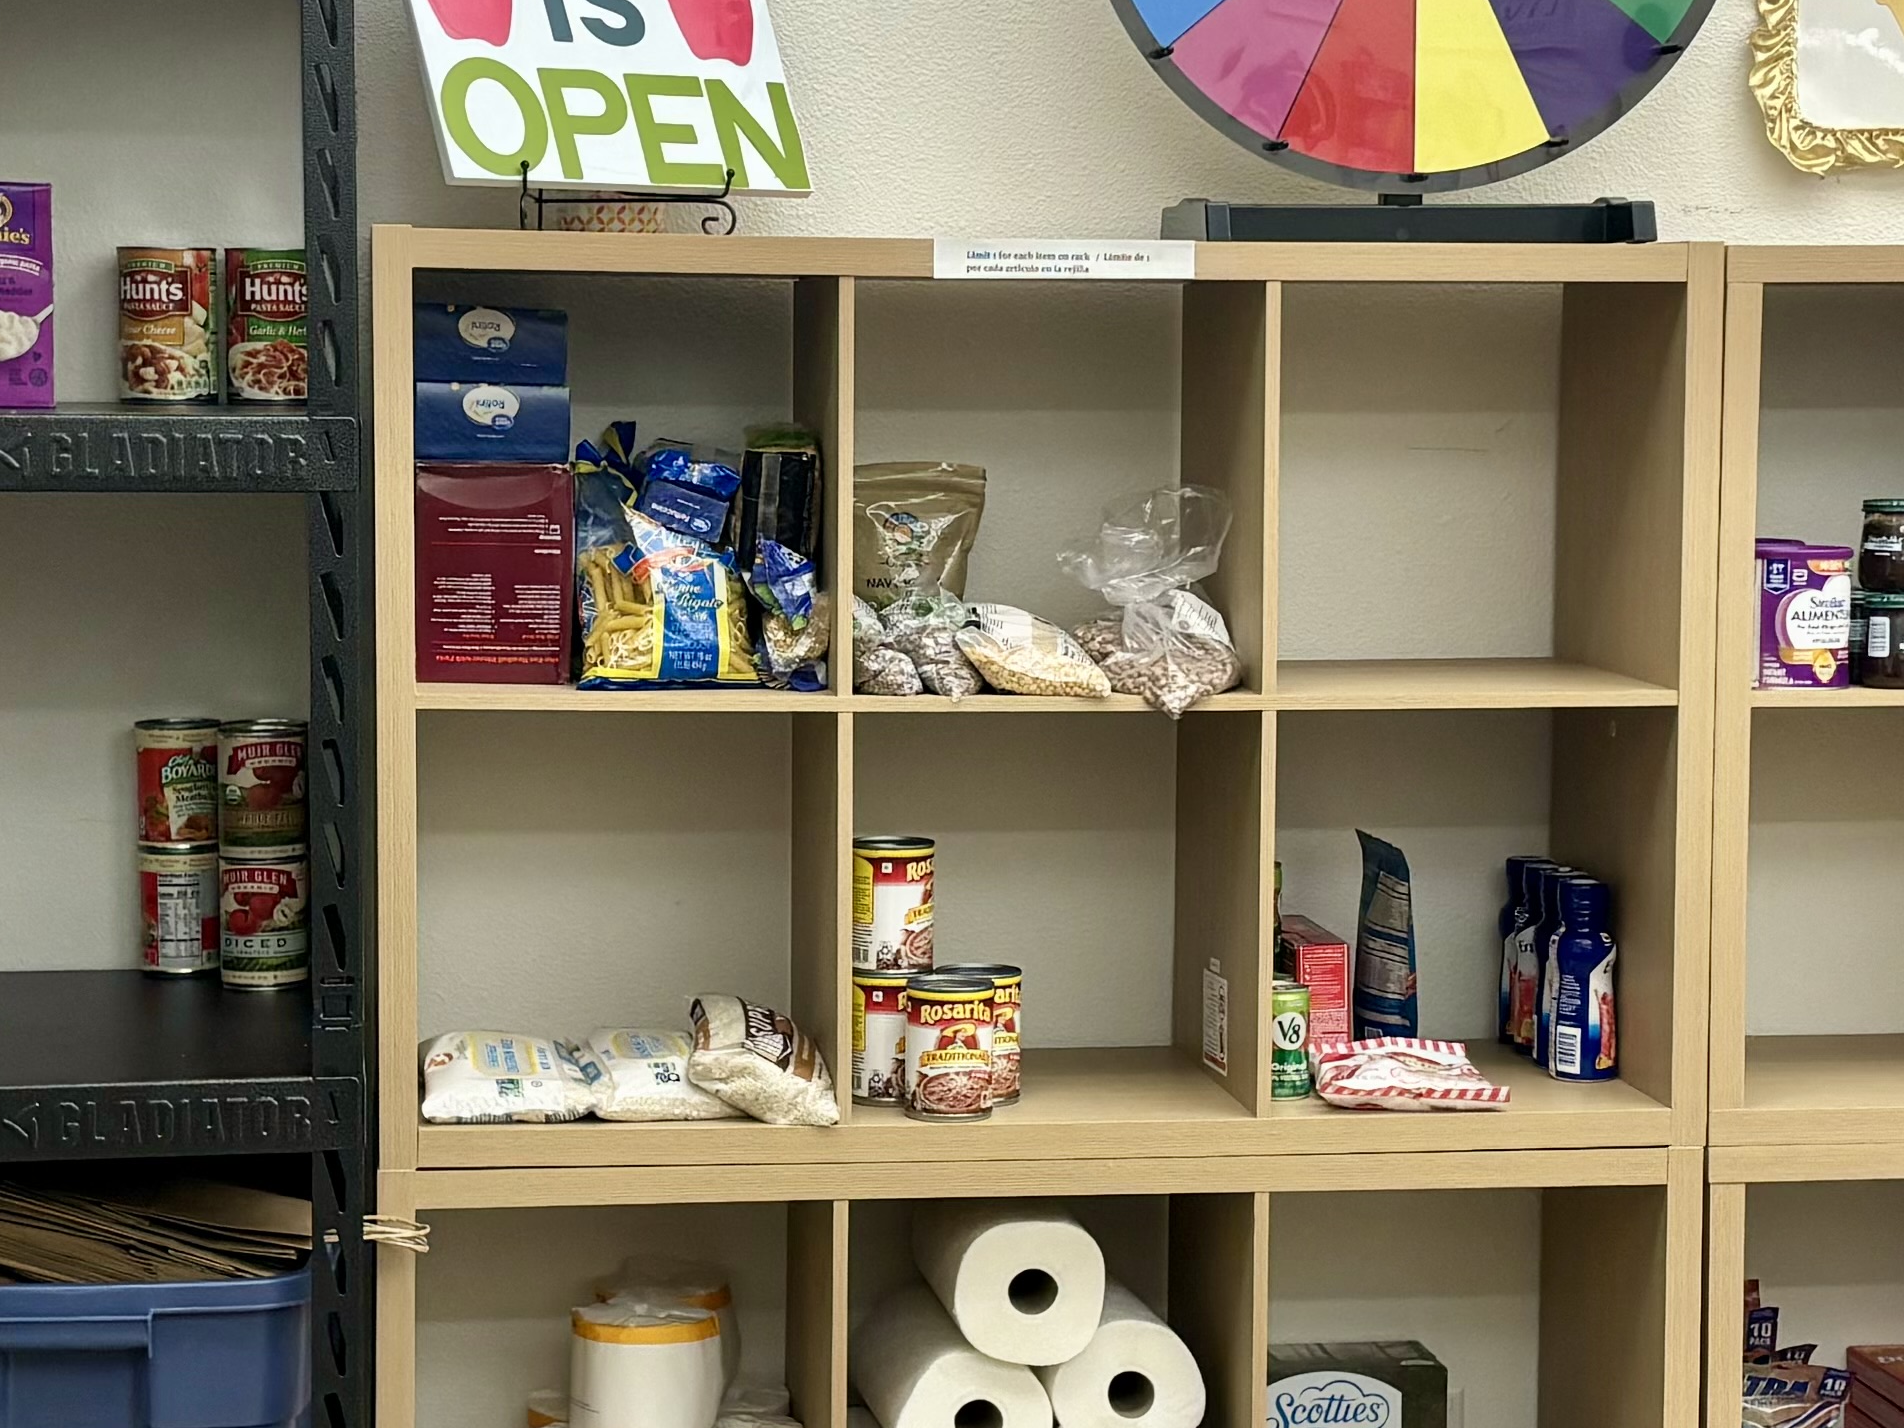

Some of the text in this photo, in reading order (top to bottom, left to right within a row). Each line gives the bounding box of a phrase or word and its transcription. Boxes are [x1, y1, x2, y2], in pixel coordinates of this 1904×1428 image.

[440, 57, 811, 189] OPEN
[967, 251, 990, 260] Limit
[999, 251, 1011, 260] for
[983, 264, 1003, 272] cada
[120, 273, 183, 303] Hunt's
[245, 273, 308, 303] Hunt's
[50, 432, 308, 477] GLADIATOR
[224, 870, 287, 884] MUIR GLEN
[225, 938, 287, 948] DICED
[921, 1001, 991, 1023] Rosarita
[1277, 1018, 1301, 1045] V8
[926, 1052, 986, 1063] TRADITIONAL
[59, 1096, 313, 1142] GLADIATOR
[1750, 1322, 1772, 1337] 10
[1824, 1378, 1844, 1391] 10
